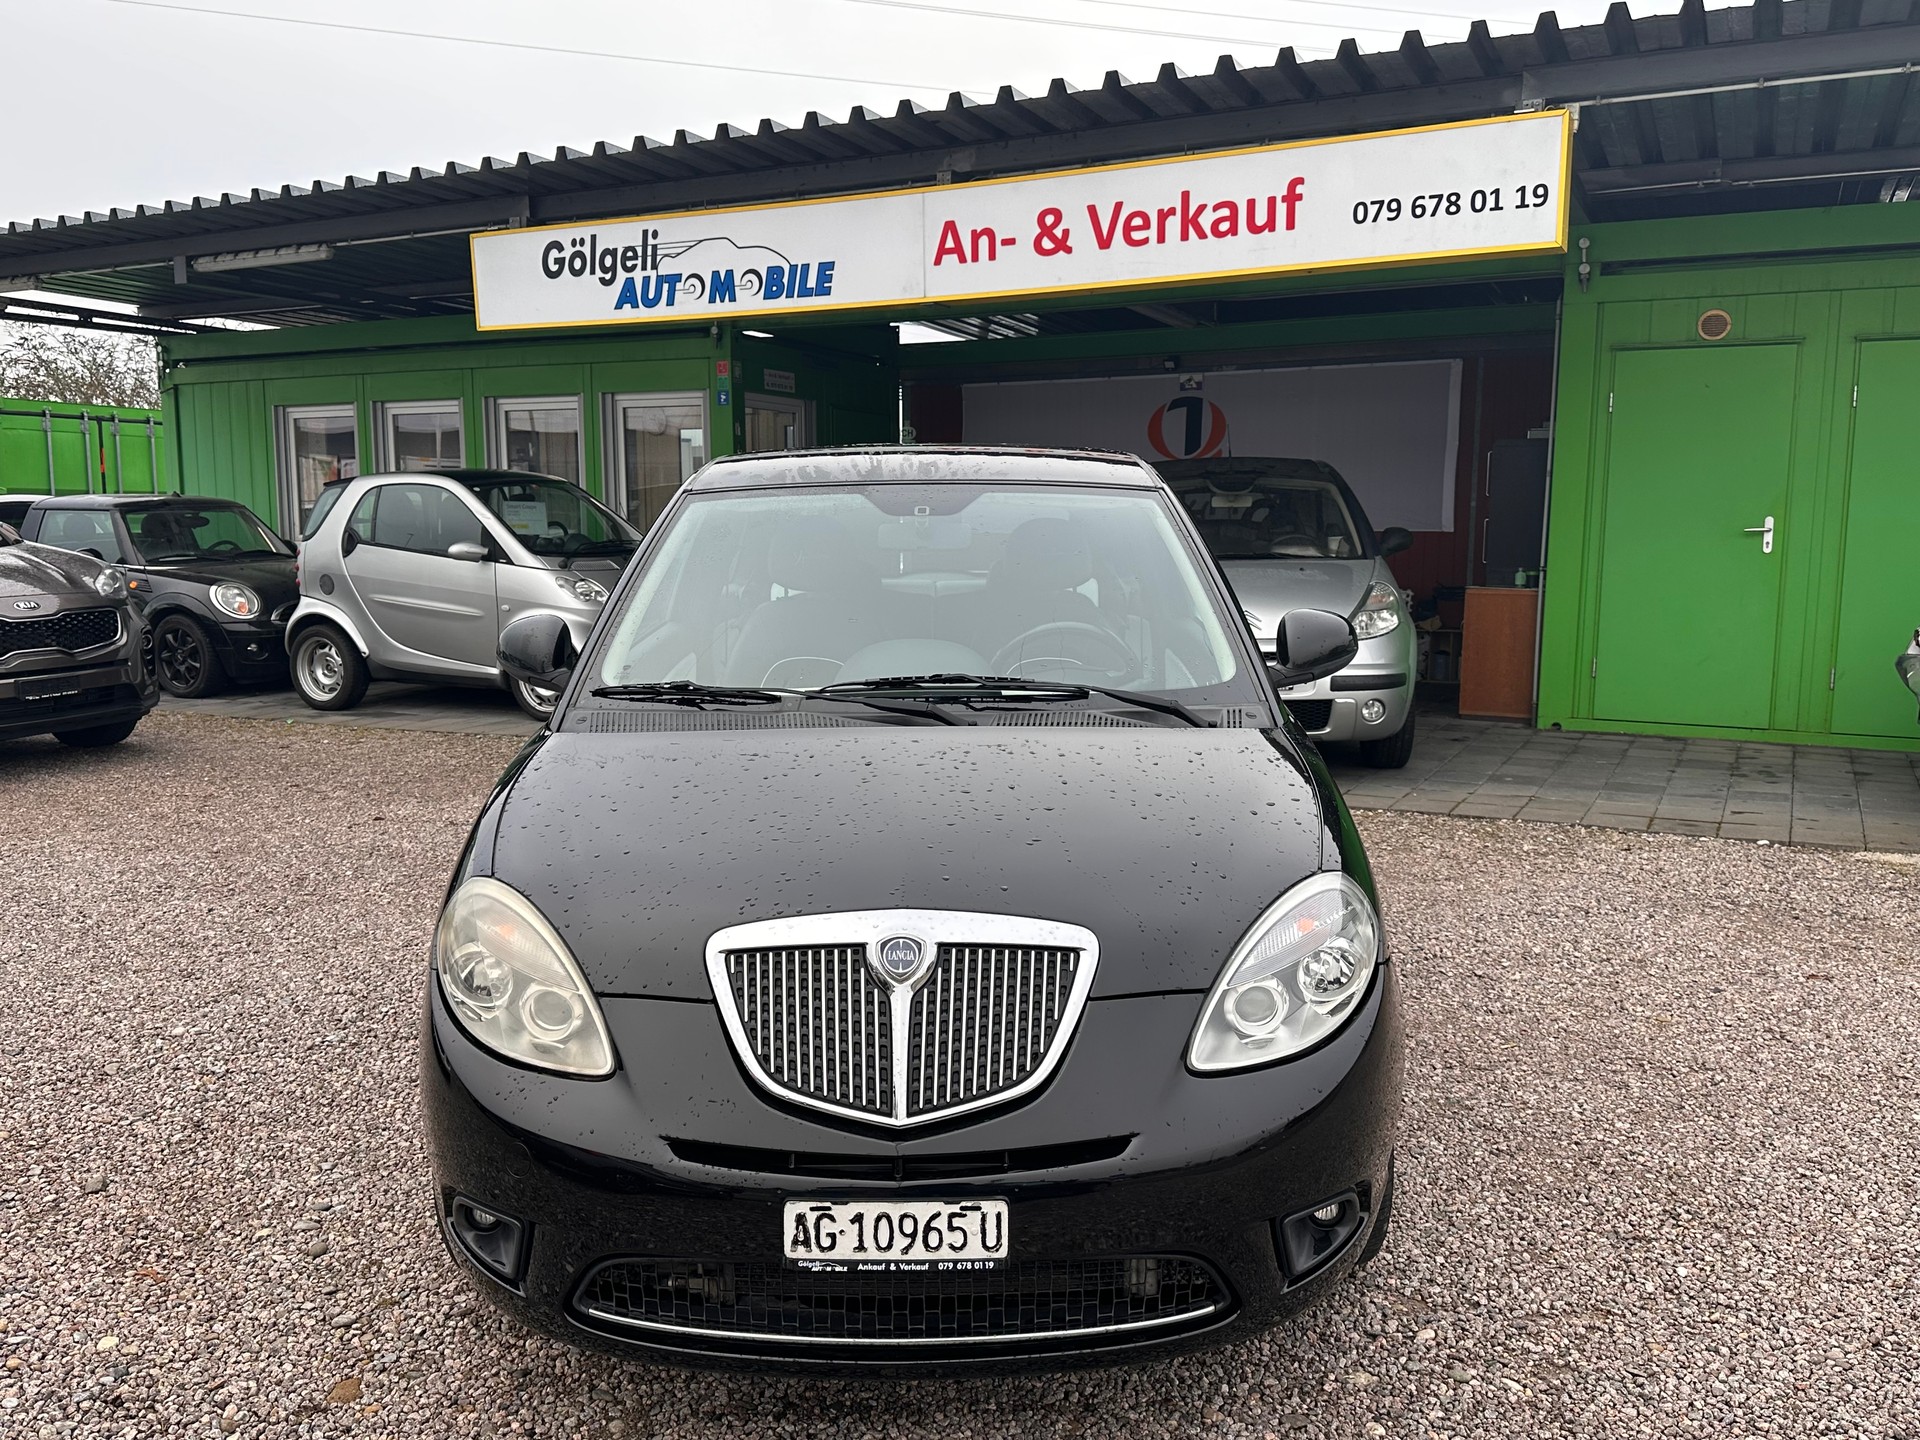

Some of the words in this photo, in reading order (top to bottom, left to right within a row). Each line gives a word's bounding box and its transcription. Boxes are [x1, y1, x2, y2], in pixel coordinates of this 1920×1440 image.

[932, 219, 1017, 267] An-
[1032, 206, 1074, 258] &
[1086, 176, 1306, 251] Verkauf
[1351, 197, 1402, 226] 079
[1411, 191, 1462, 220] 678
[1470, 187, 1505, 215] 01
[1514, 182, 1550, 210] 19
[541, 229, 659, 287] Gölgeli
[887, 950, 915, 961] LANCIA
[857, 1262, 886, 1271] Ankauf
[889, 1262, 897, 1271] &
[899, 1262, 930, 1271] Verkauf
[937, 1262, 954, 1270] 079
[956, 1261, 972, 1270] 678
